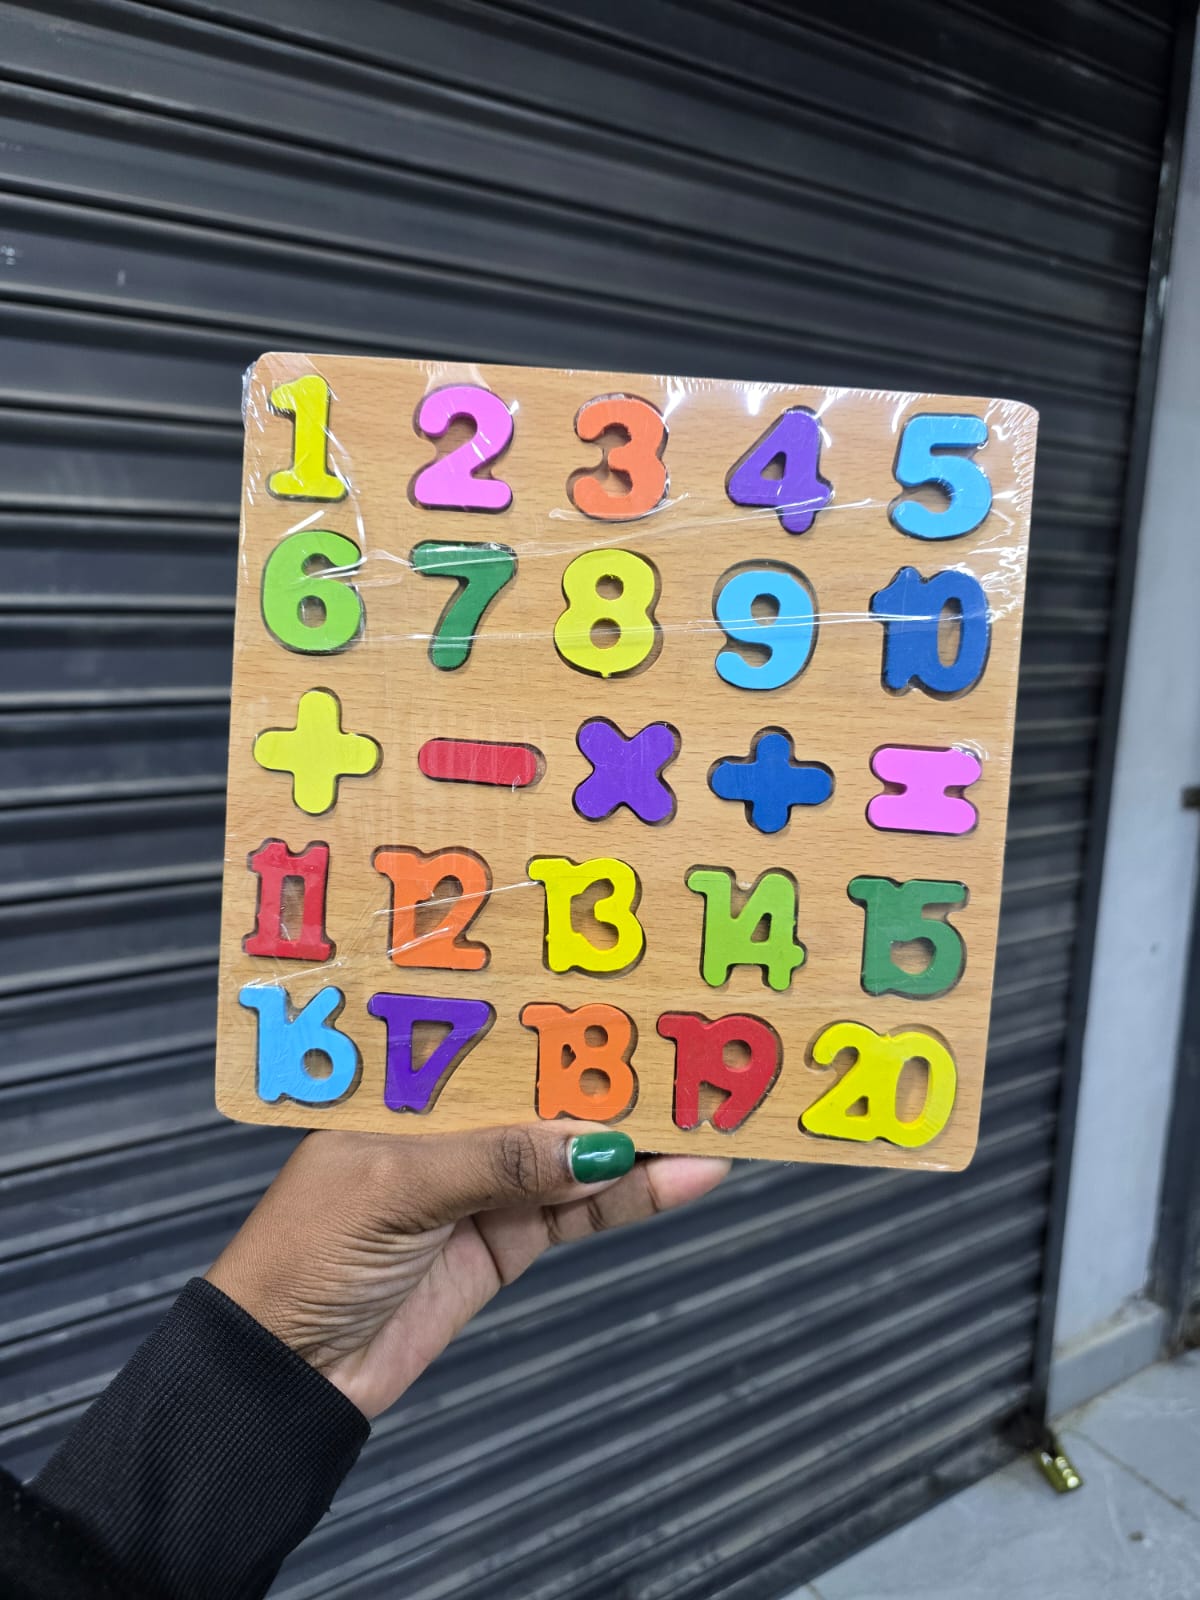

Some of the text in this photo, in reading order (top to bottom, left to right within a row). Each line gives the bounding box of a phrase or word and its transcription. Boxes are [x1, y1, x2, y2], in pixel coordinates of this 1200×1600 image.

[270, 374, 992, 539] 1 2 3 4 5
[262, 531, 990, 693] 6 7 8 9 10
[244, 841, 967, 995] 11 12 13 14 15
[239, 985, 957, 1148] 16 17 18 19 20
